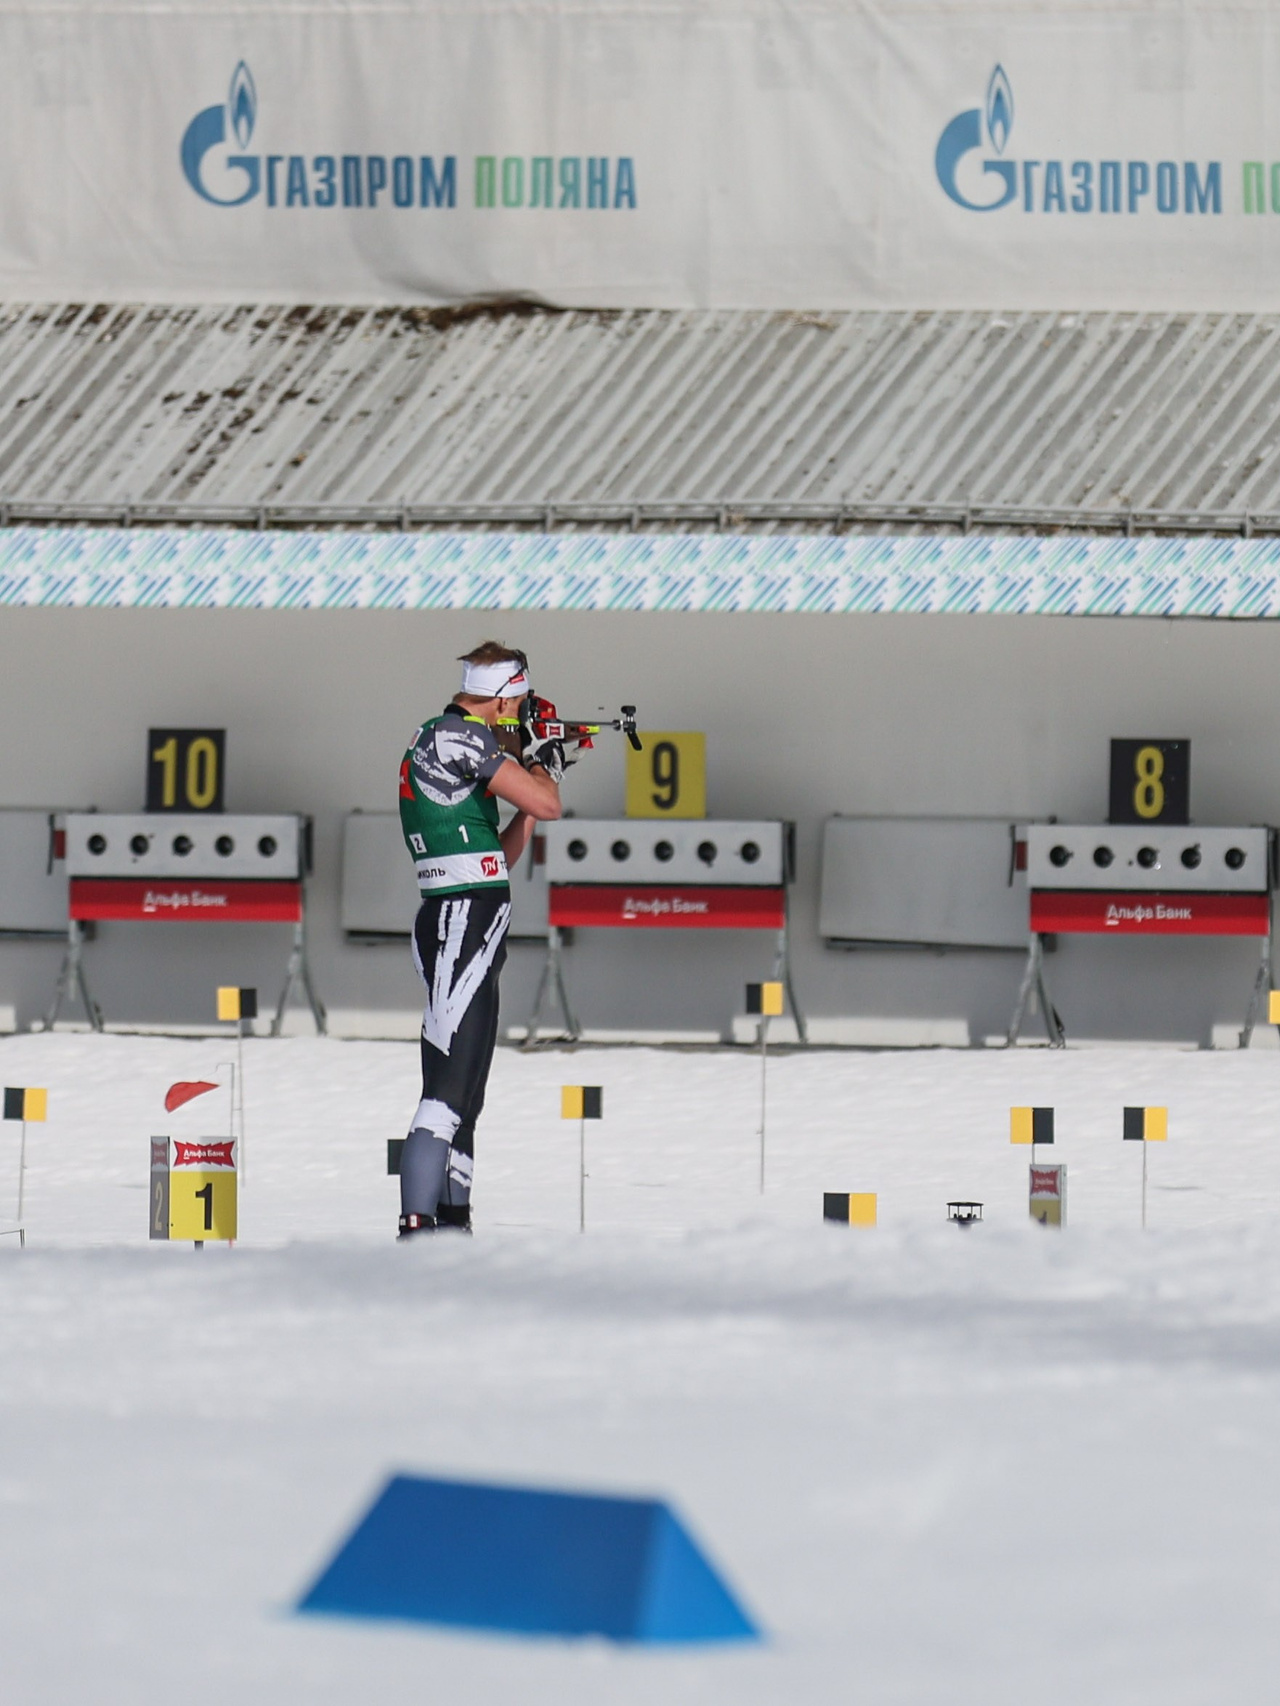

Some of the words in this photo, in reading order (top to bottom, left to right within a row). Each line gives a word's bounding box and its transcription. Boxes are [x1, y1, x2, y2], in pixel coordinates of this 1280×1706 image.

[266, 155, 457, 208] ГАЗПРОМ
[474, 156, 638, 209] ПОЛЯНА
[1022, 160, 1222, 213] ГАЗПРОМ
[153, 737, 218, 809] 10
[652, 741, 679, 810] 9
[1134, 746, 1164, 818] 8
[458, 824, 469, 843] 1
[1106, 905, 1153, 924] Альфа
[1156, 905, 1192, 920] Банк
[195, 1182, 213, 1231] 1
